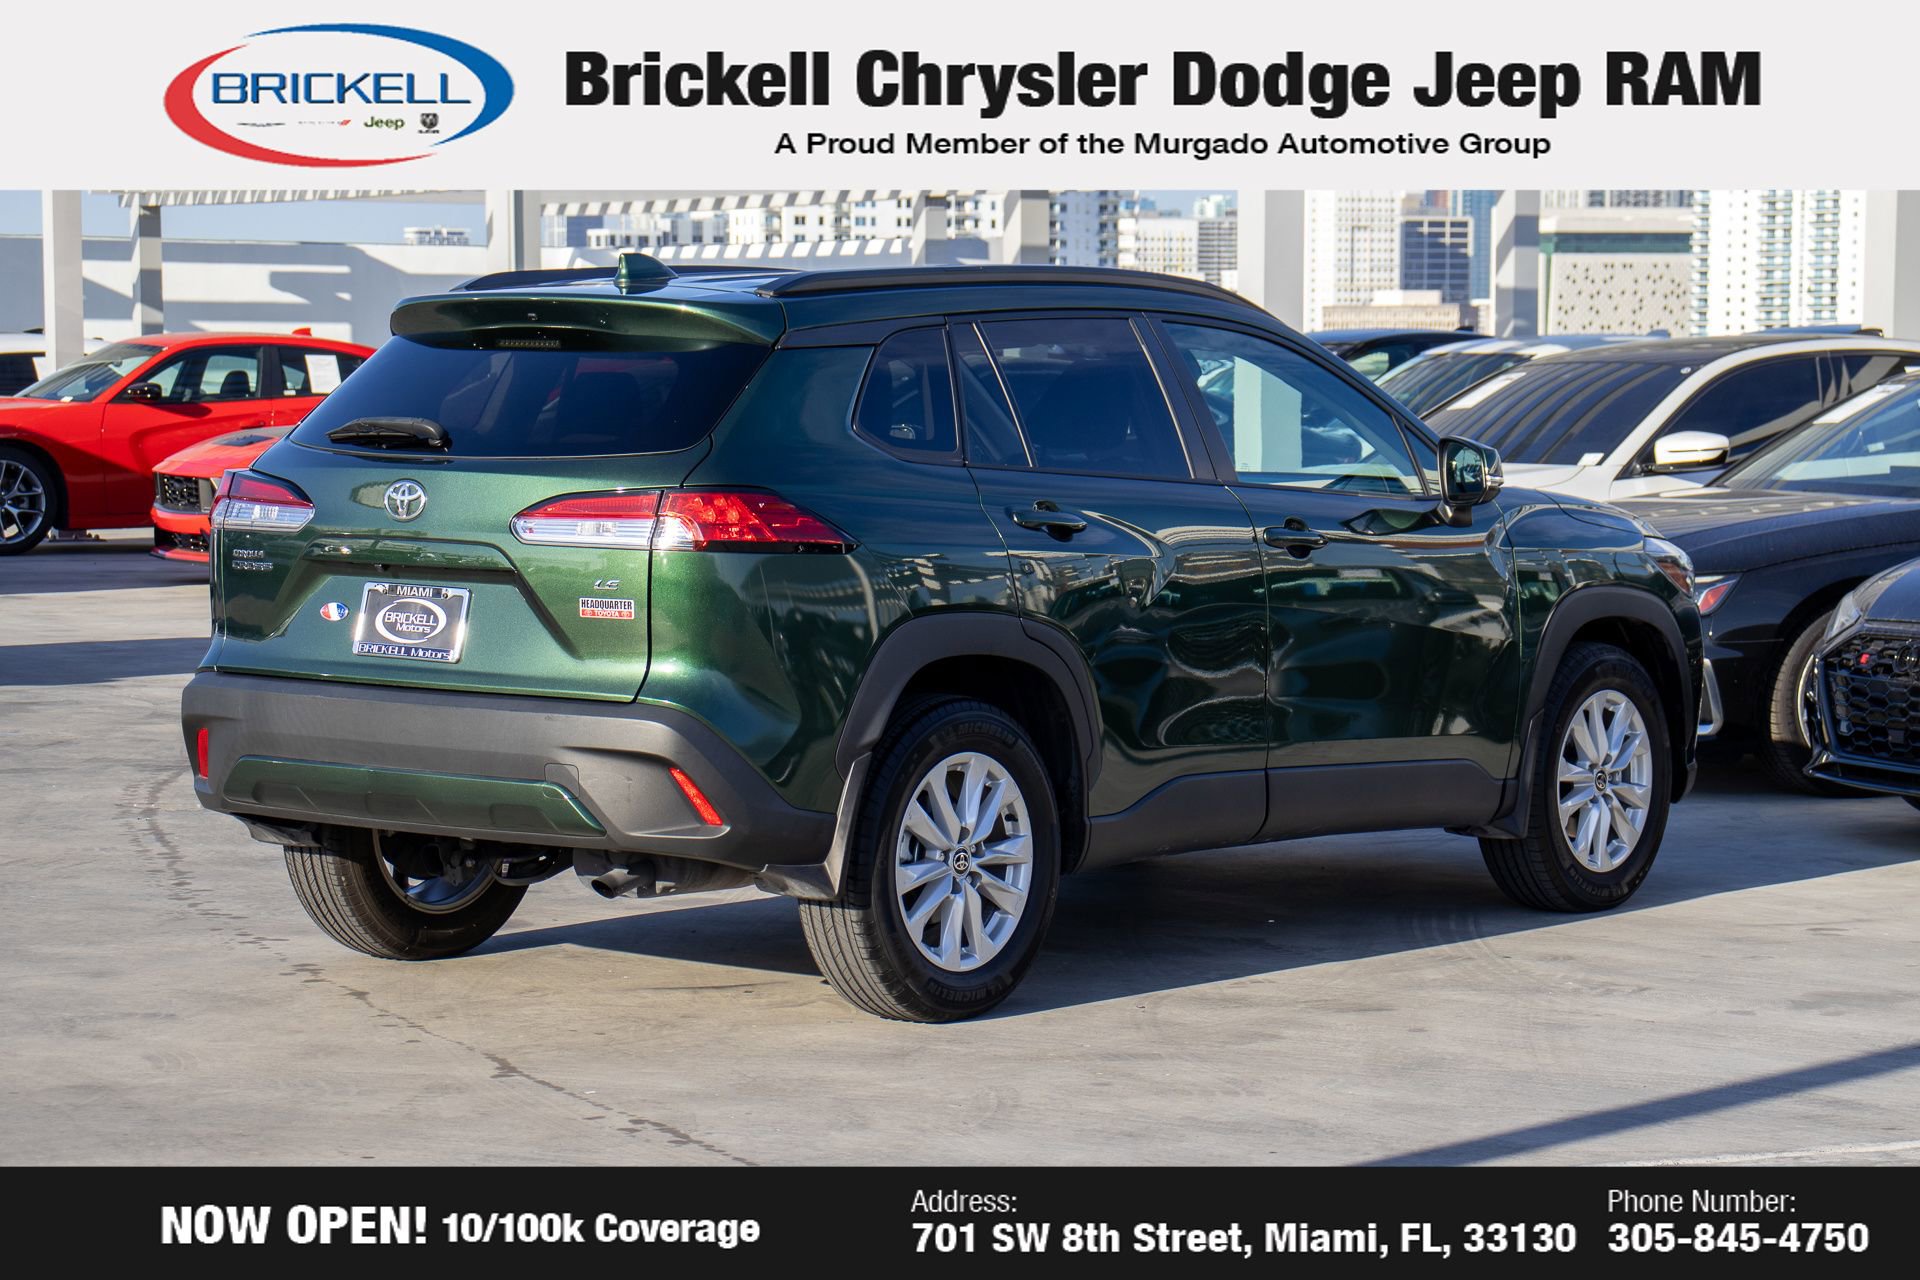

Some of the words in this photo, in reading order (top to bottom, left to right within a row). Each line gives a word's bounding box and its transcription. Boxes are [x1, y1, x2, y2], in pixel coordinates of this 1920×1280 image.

[594, 579, 621, 590] LE
[396, 585, 433, 597] MIAMI
[581, 599, 632, 610] HEADQUARTER
[385, 612, 437, 626] BRICKELL
[595, 610, 619, 618] TOYOTA
[396, 622, 431, 633] Motors
[358, 643, 408, 656] BRICKELL
[410, 648, 451, 661] Motors
[958, 721, 1016, 745] MICHELIN
[928, 981, 987, 1001] MICHELIN
